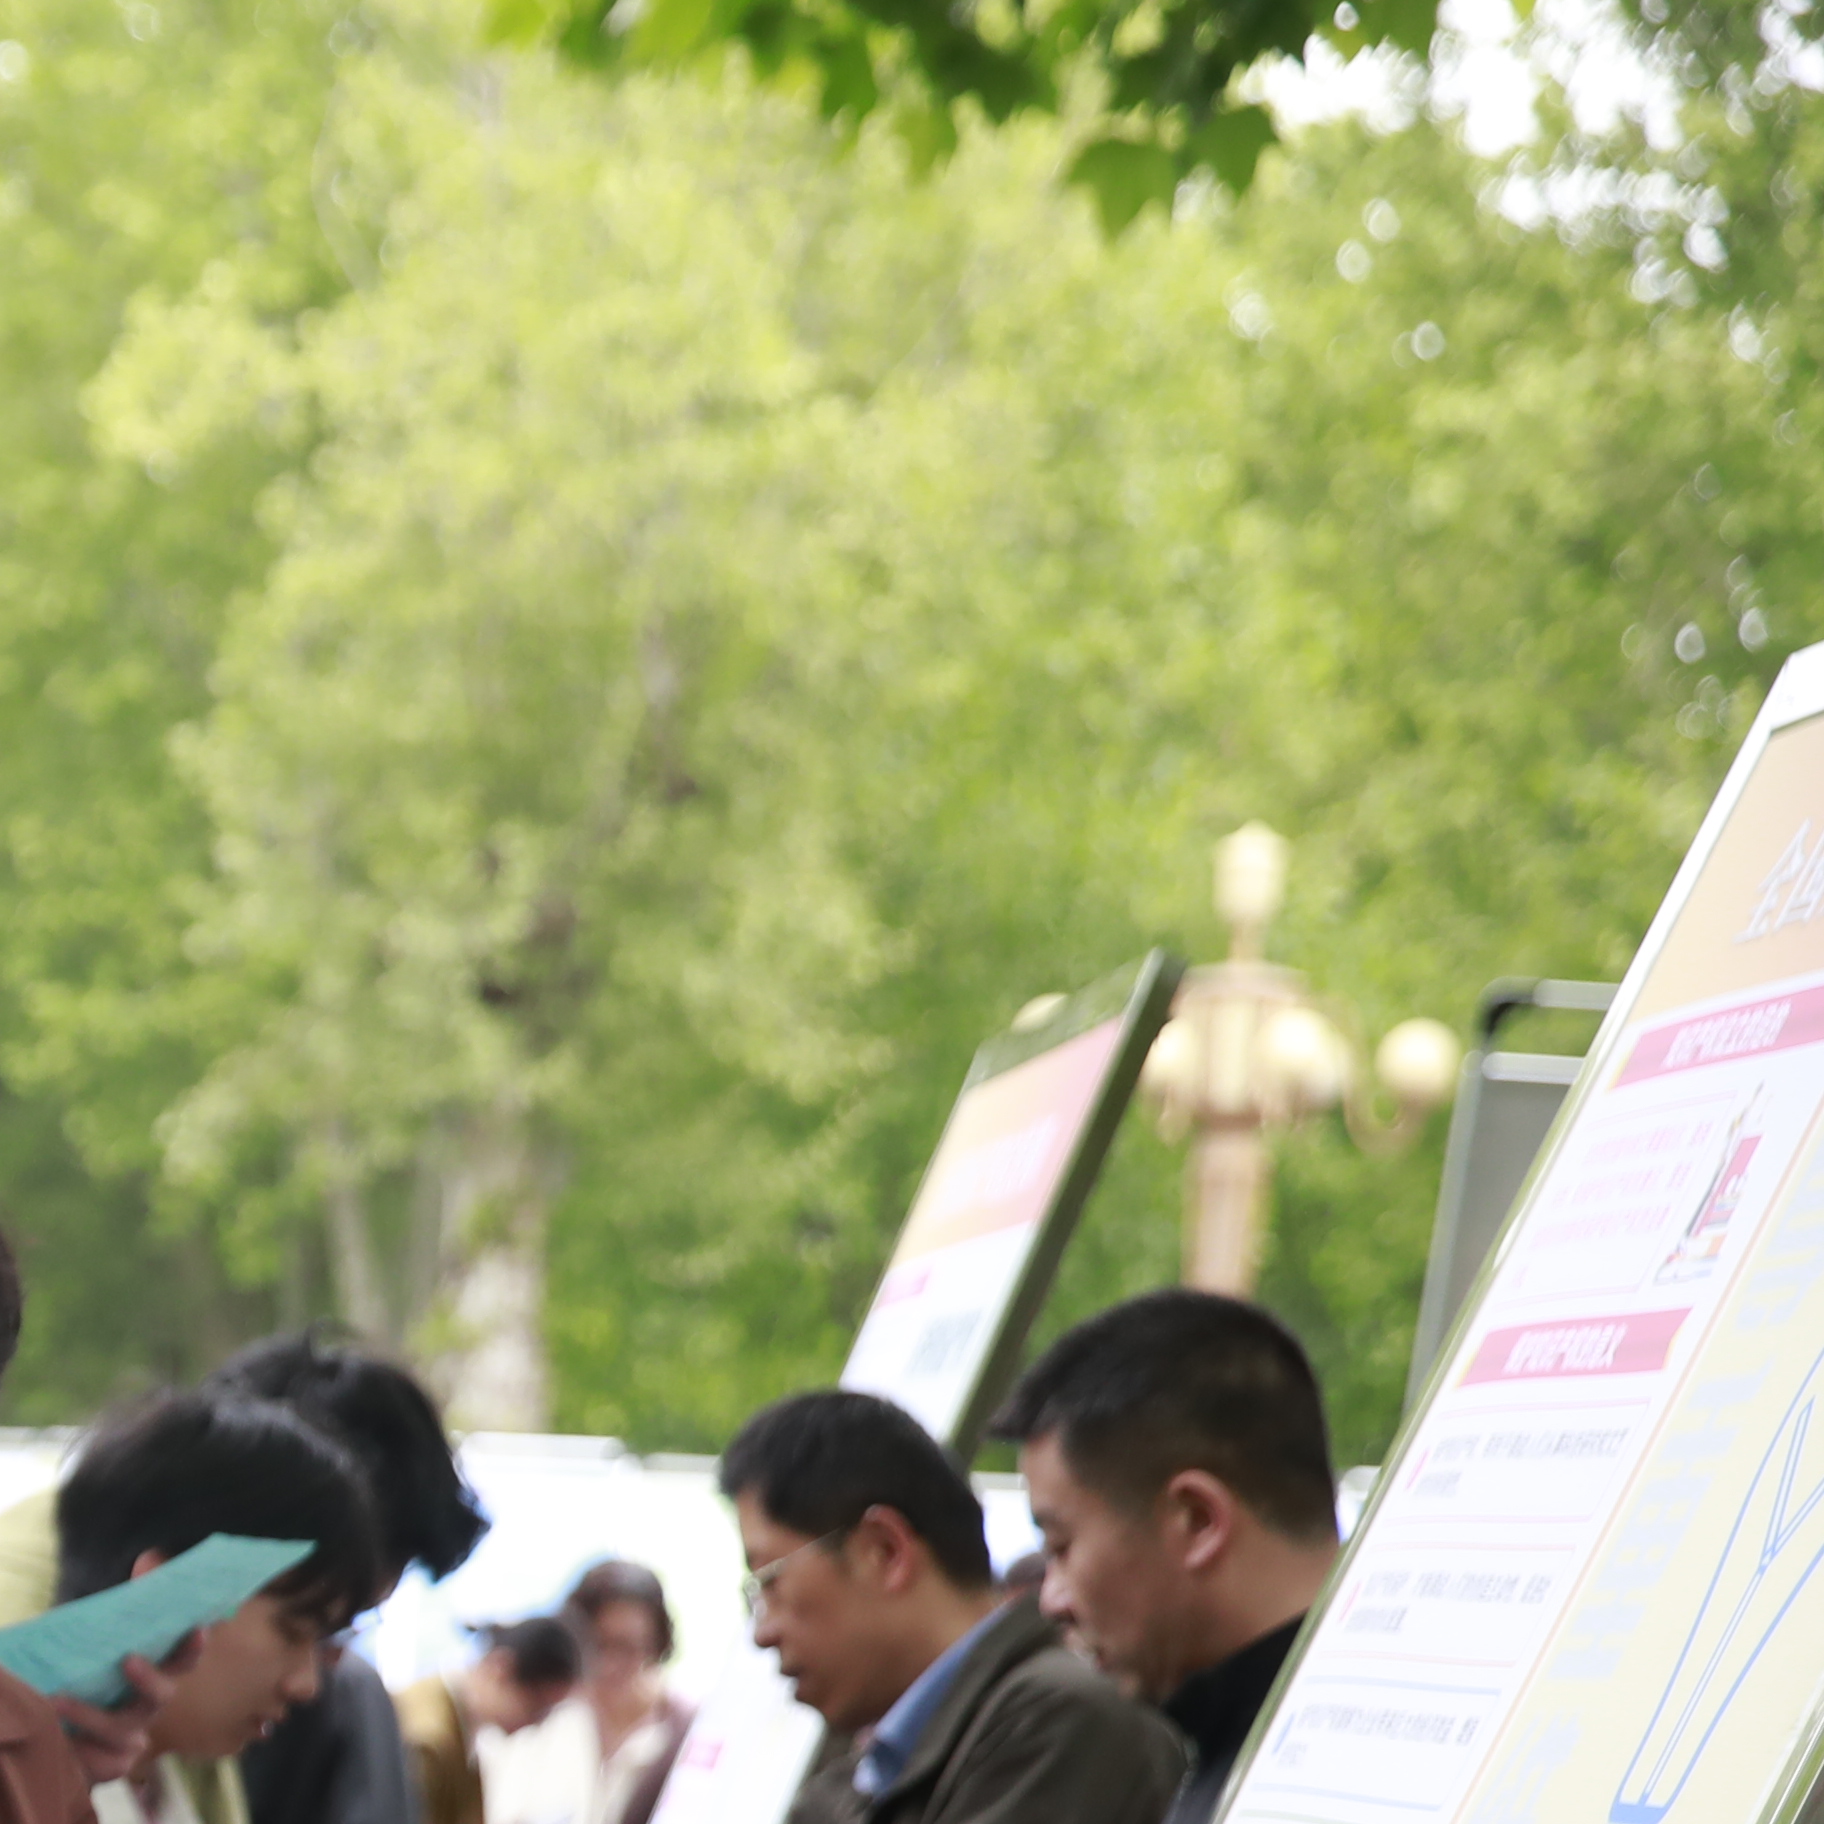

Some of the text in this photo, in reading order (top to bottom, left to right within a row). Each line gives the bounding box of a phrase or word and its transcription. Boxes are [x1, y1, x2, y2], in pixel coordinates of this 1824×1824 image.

[1498, 1322, 1633, 1377] 保护知识产权的意义
